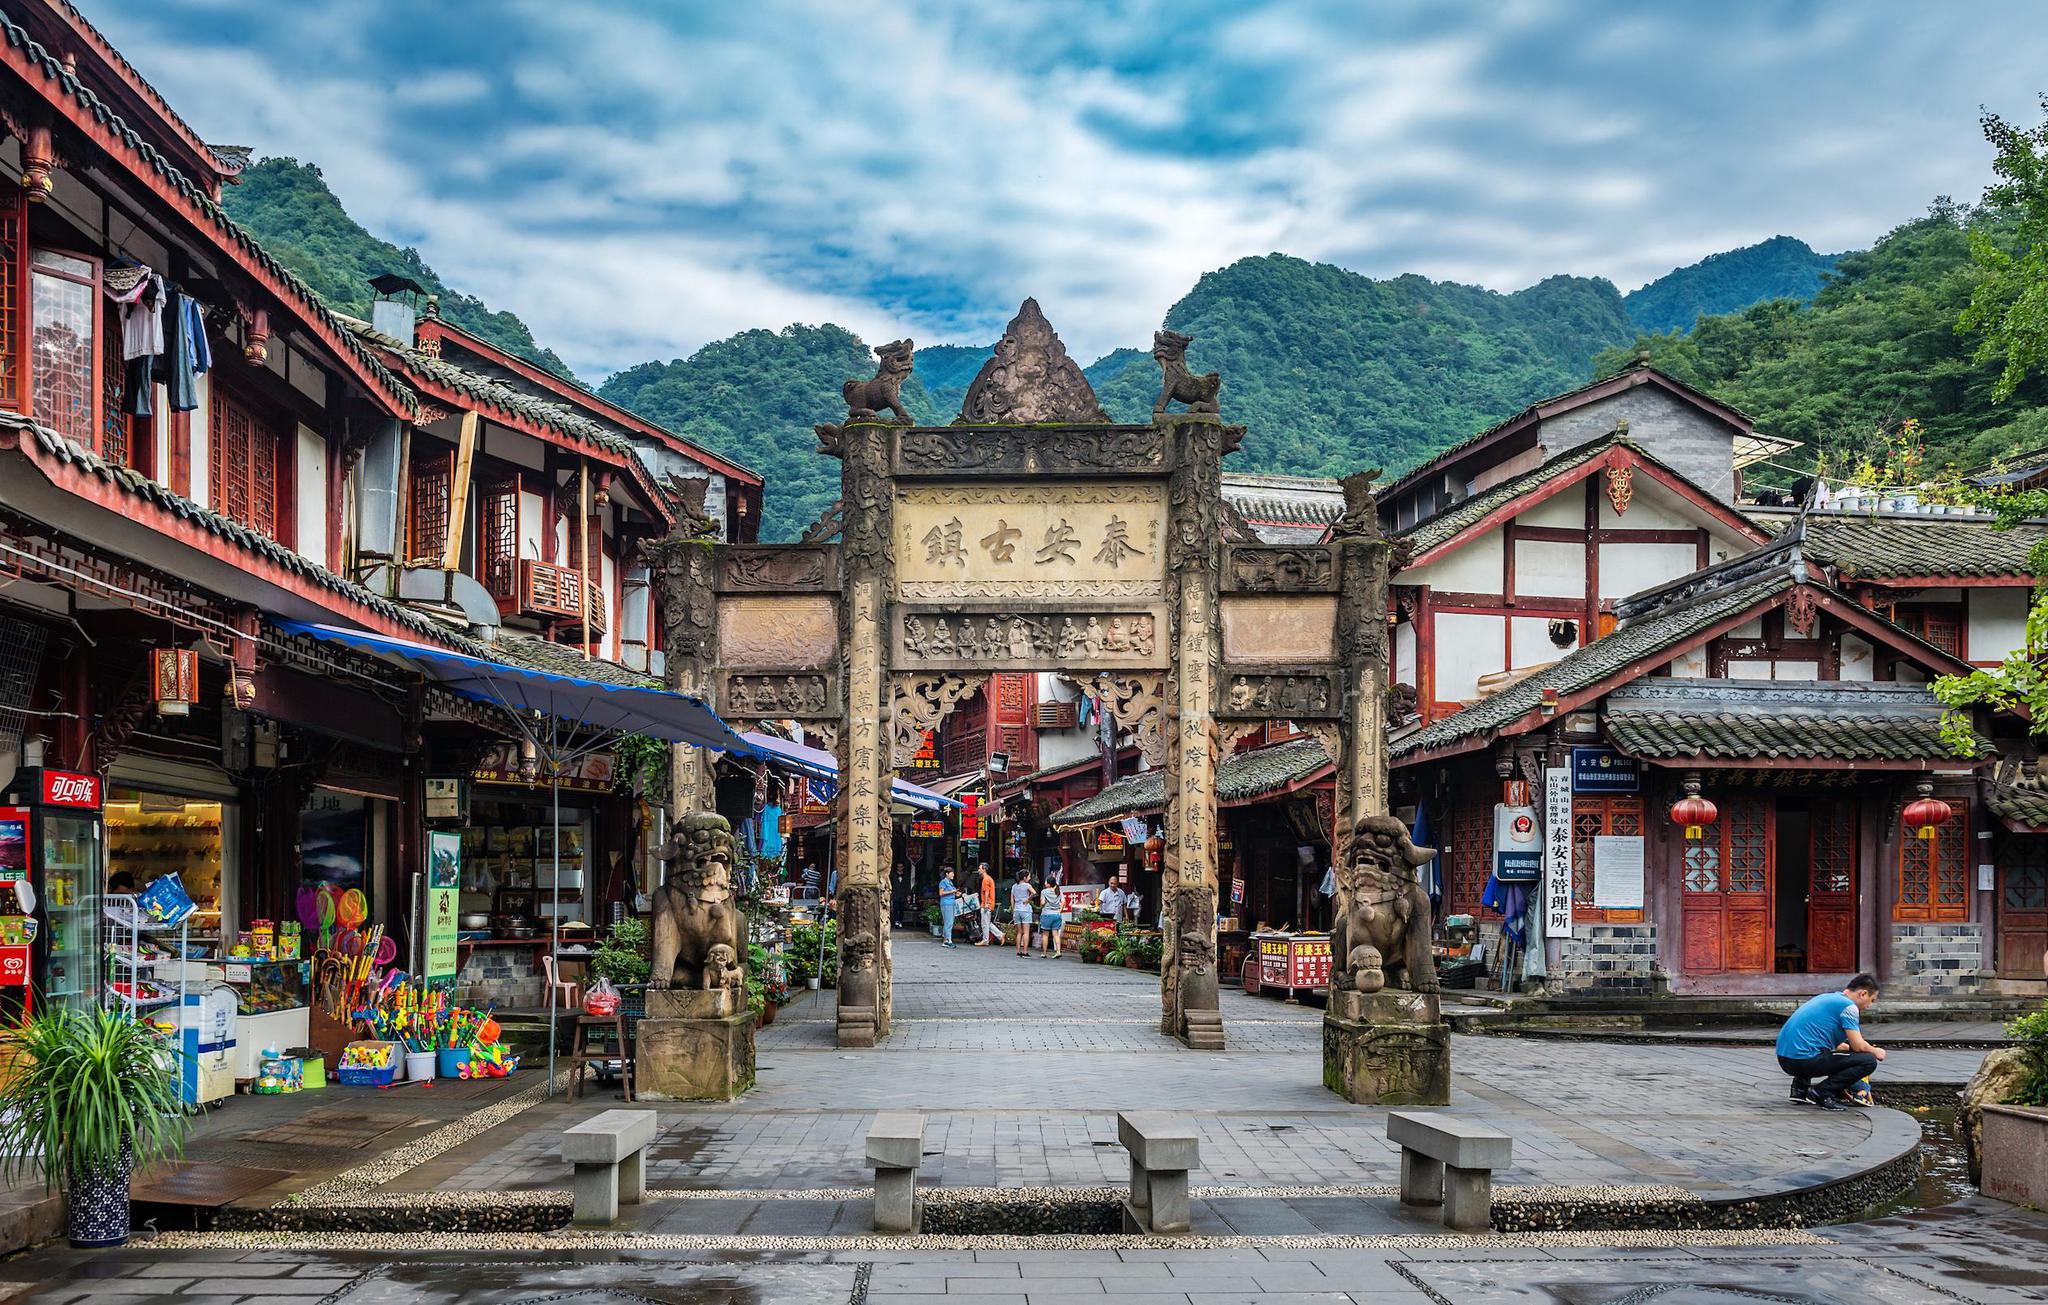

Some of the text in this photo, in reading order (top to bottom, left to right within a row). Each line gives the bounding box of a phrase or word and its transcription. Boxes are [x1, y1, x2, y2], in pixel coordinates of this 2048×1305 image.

[921, 514, 1145, 569] 泰安古鎮
[51, 776, 94, 802] 可口可乐
[1550, 827, 1569, 929] 泰安寺管理所
